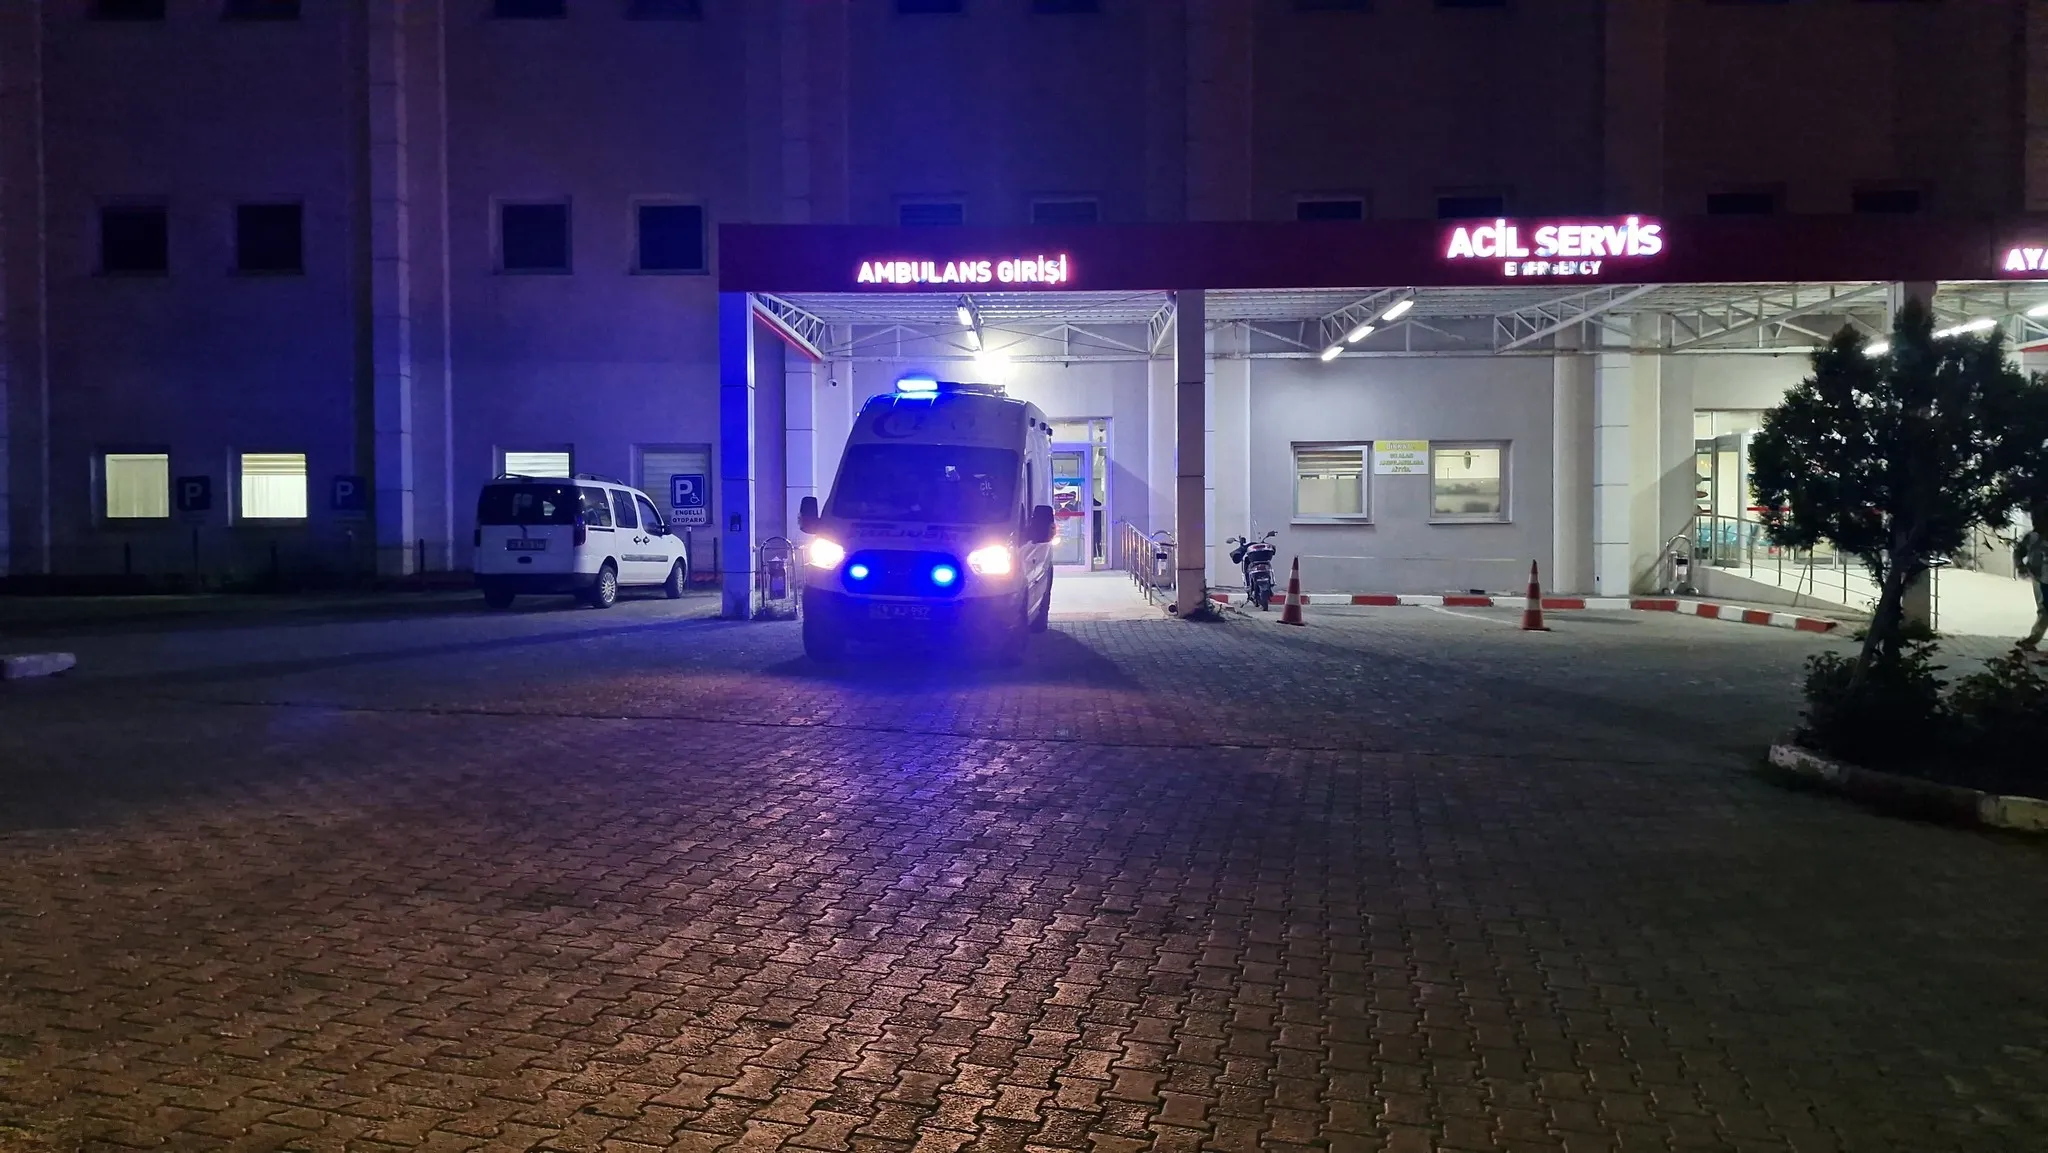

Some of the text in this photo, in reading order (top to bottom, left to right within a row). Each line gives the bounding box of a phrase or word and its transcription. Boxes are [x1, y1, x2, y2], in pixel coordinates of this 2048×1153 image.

[1446, 216, 1663, 259] ACİL SERVİS
[857, 261, 992, 283] AMBULANS
[185, 482, 203, 507] P
[335, 480, 354, 506] P
[676, 480, 692, 503] P
